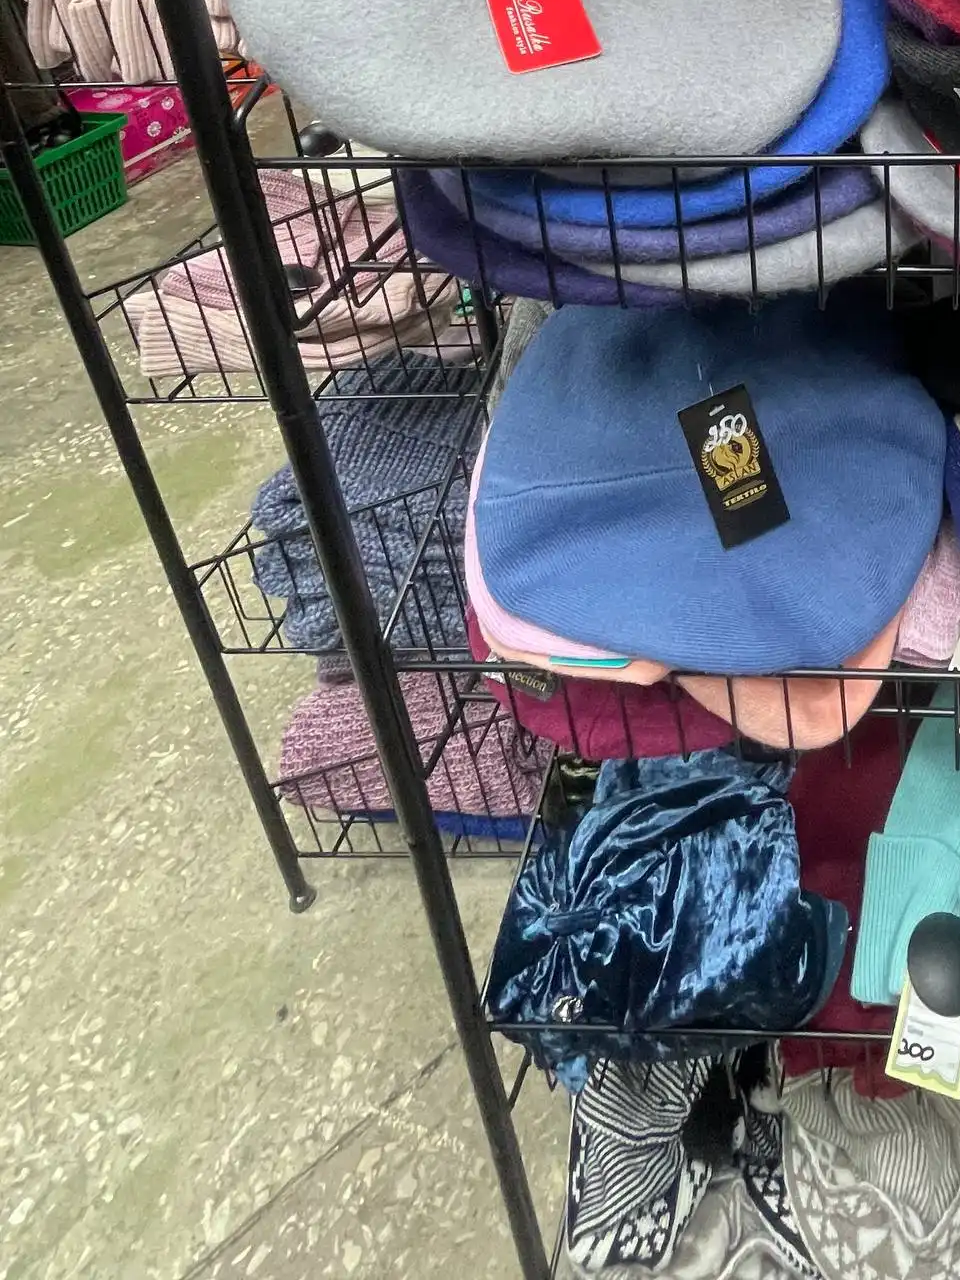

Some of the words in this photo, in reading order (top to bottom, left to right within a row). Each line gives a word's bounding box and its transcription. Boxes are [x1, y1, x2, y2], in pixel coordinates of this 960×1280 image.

[517, 0, 552, 52] Rusalka
[723, 462, 757, 486] ASLAN
[897, 1038, 935, 1061] 300
